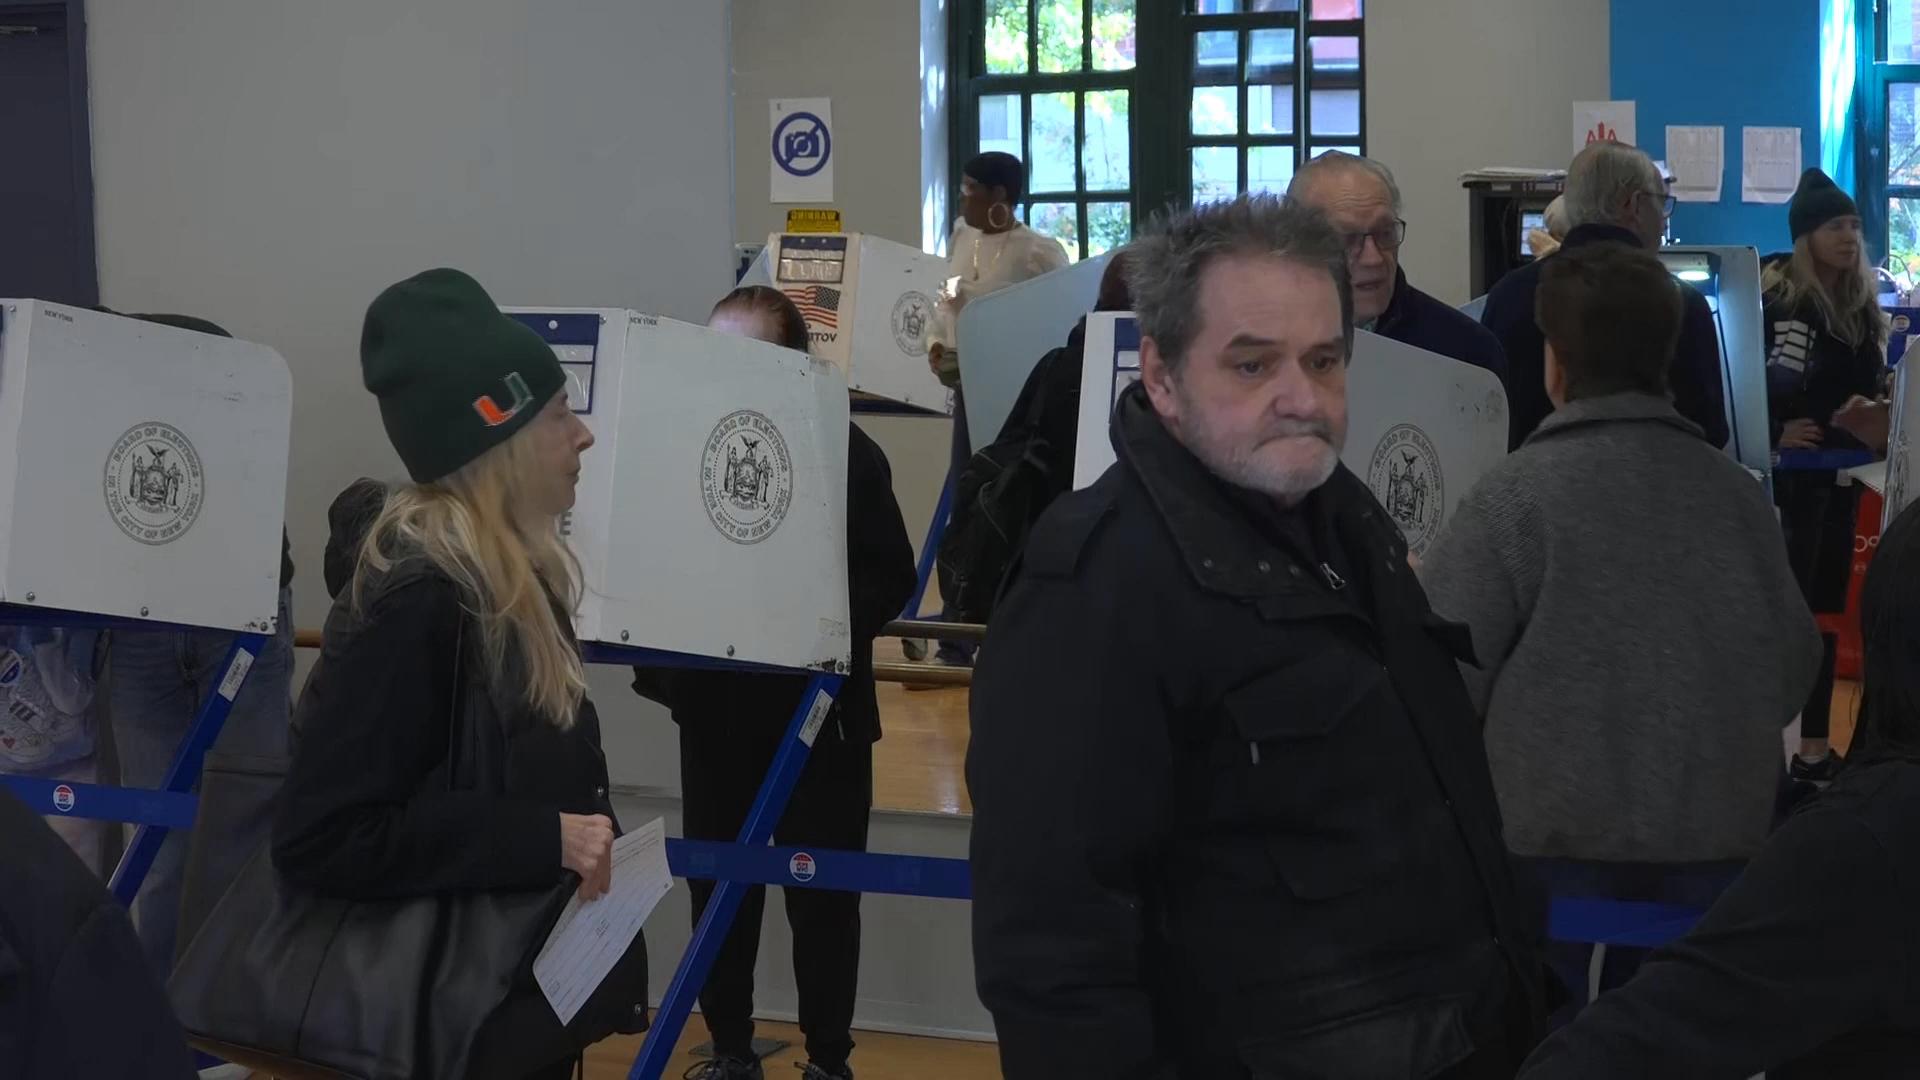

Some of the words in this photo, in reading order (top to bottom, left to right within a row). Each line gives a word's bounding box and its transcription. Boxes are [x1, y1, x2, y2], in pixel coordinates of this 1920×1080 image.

[472, 372, 534, 427] U
[113, 430, 143, 462] BOARD
[144, 427, 158, 438] OF
[160, 428, 199, 478] ELECTIONS
[709, 418, 738, 453] BOARD
[738, 415, 751, 426] OF
[752, 418, 788, 472] ELECTIONS
[144, 530, 158, 540] OF
[736, 527, 750, 538] OF
